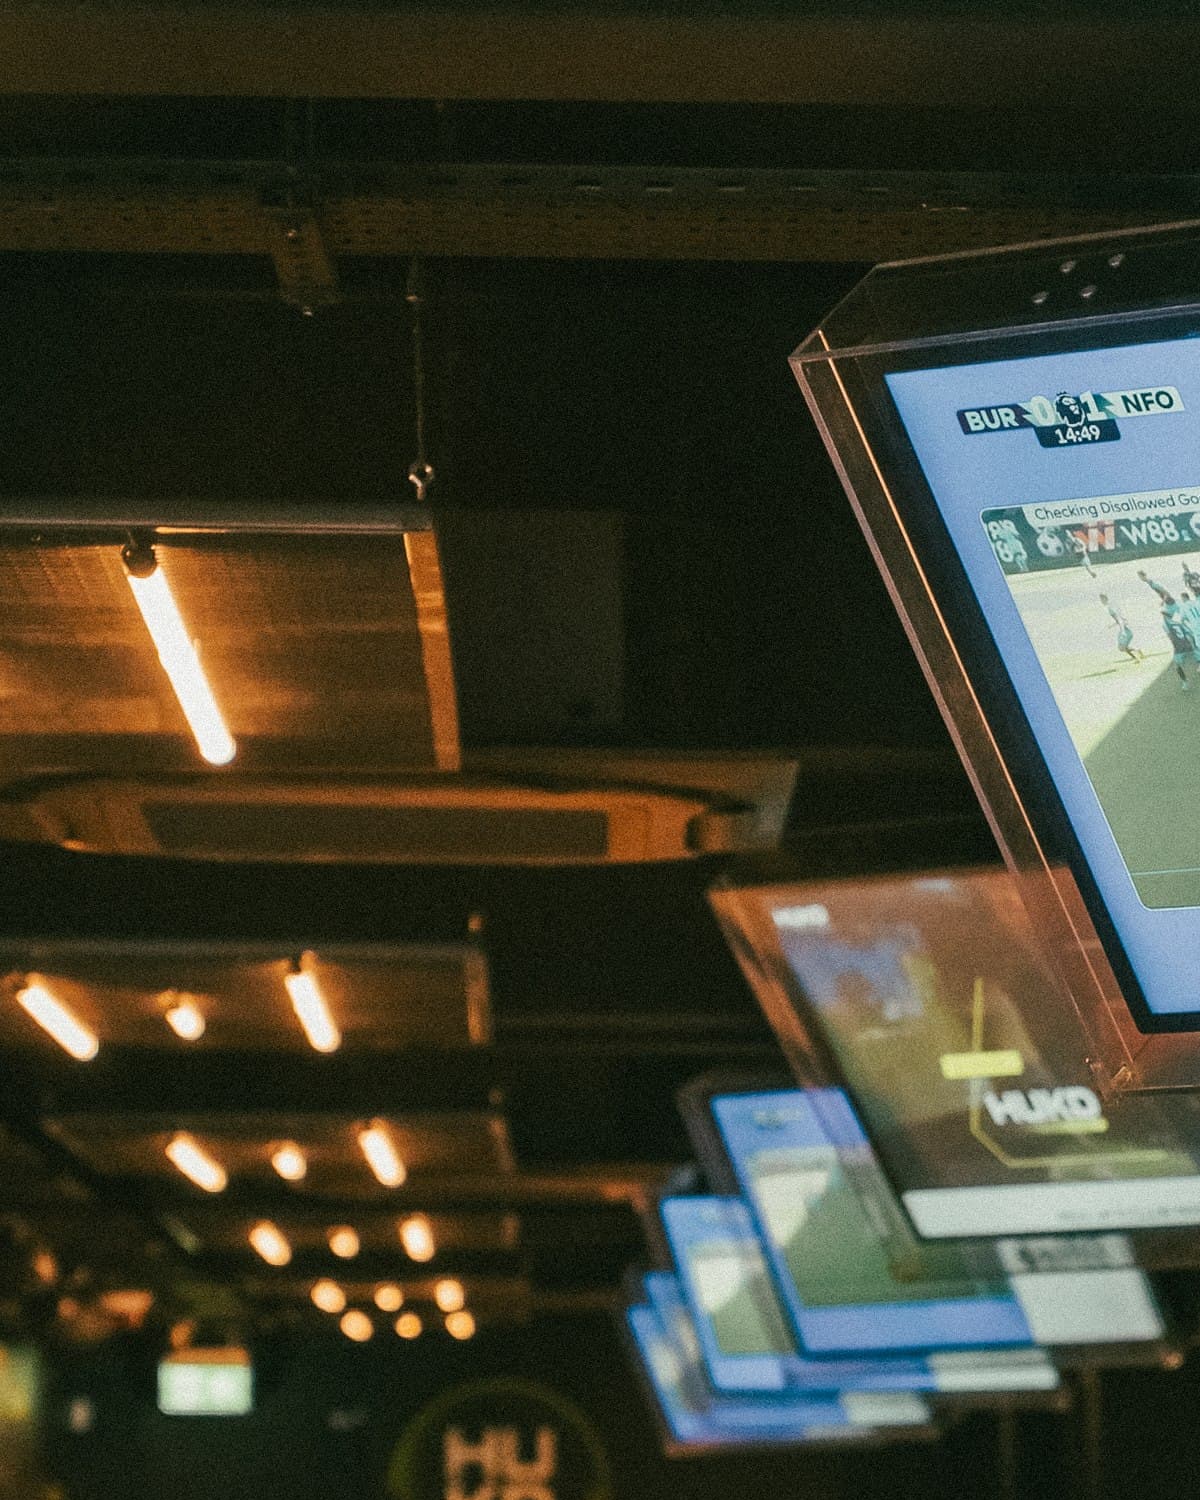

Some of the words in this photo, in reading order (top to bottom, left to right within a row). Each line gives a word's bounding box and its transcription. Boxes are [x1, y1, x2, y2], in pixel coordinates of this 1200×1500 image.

[1030, 395, 1053, 426] 0
[1080, 391, 1108, 421] 1
[1121, 390, 1173, 414] NFO
[964, 407, 1020, 432] BUR
[1055, 425, 1101, 444] 14:49
[1035, 502, 1098, 521] Checking
[1100, 494, 1176, 513] Disallowed
[1119, 518, 1180, 546] W88
[444, 1427, 557, 1483] HU
